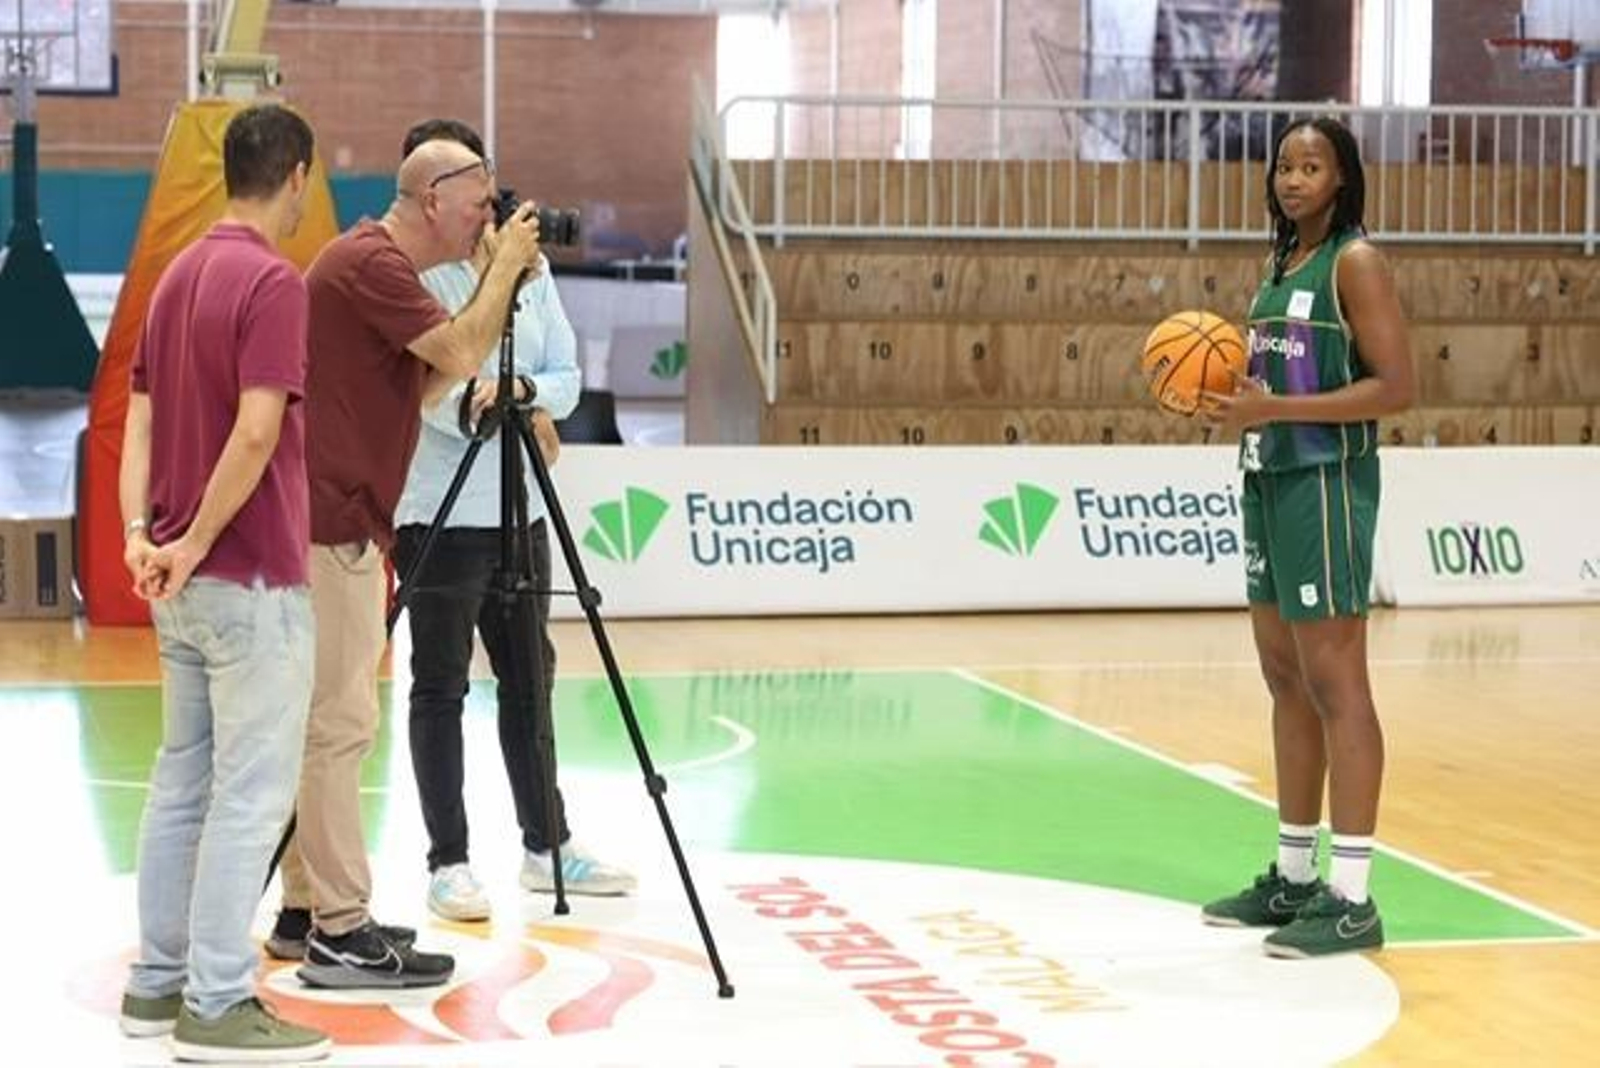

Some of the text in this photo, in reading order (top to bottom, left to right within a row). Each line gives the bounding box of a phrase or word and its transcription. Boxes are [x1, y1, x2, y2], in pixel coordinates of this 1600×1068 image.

[870, 341, 892, 360] 10
[972, 342, 985, 360] 9
[1066, 342, 1078, 360] 8
[799, 426, 820, 445] 11
[901, 427, 925, 445] 10
[1005, 426, 1018, 445] 9
[1201, 426, 1212, 445] 7
[685, 489, 914, 527] Fundación
[1074, 484, 1239, 519] Fundaci
[690, 528, 856, 573] Unicaja
[1081, 521, 1239, 564] Unicaja
[725, 877, 1057, 1068] COSTA DEL SOL
